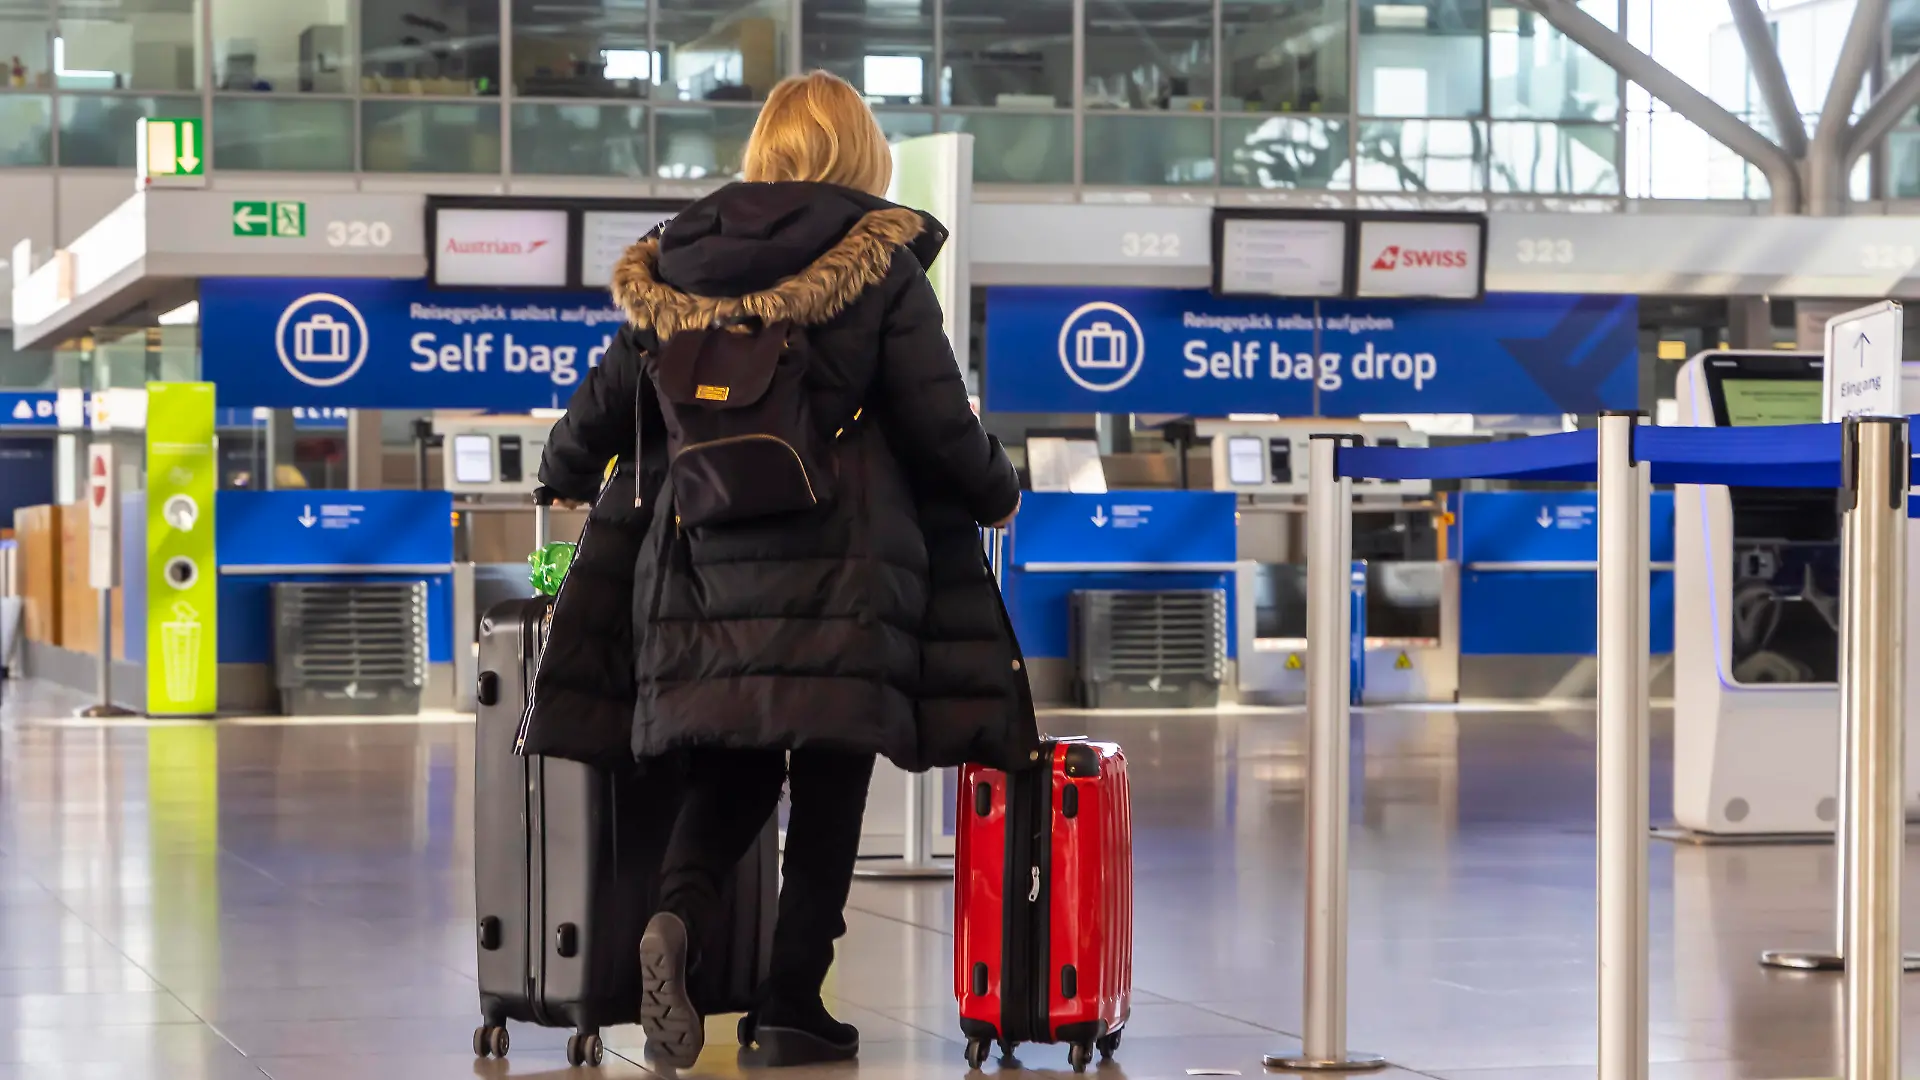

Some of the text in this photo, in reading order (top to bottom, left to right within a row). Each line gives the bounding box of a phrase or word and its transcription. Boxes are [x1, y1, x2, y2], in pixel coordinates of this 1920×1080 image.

[327, 221, 392, 246] 320
[1122, 232, 1181, 257] 322
[446, 238, 522, 254] Austrian
[1516, 238, 1574, 262] 323
[1402, 250, 1468, 268] SWISS
[410, 332, 494, 372] Self
[503, 333, 578, 385] bag
[1183, 340, 1437, 391] Self bag drop
[1841, 375, 1882, 398] Eingang
